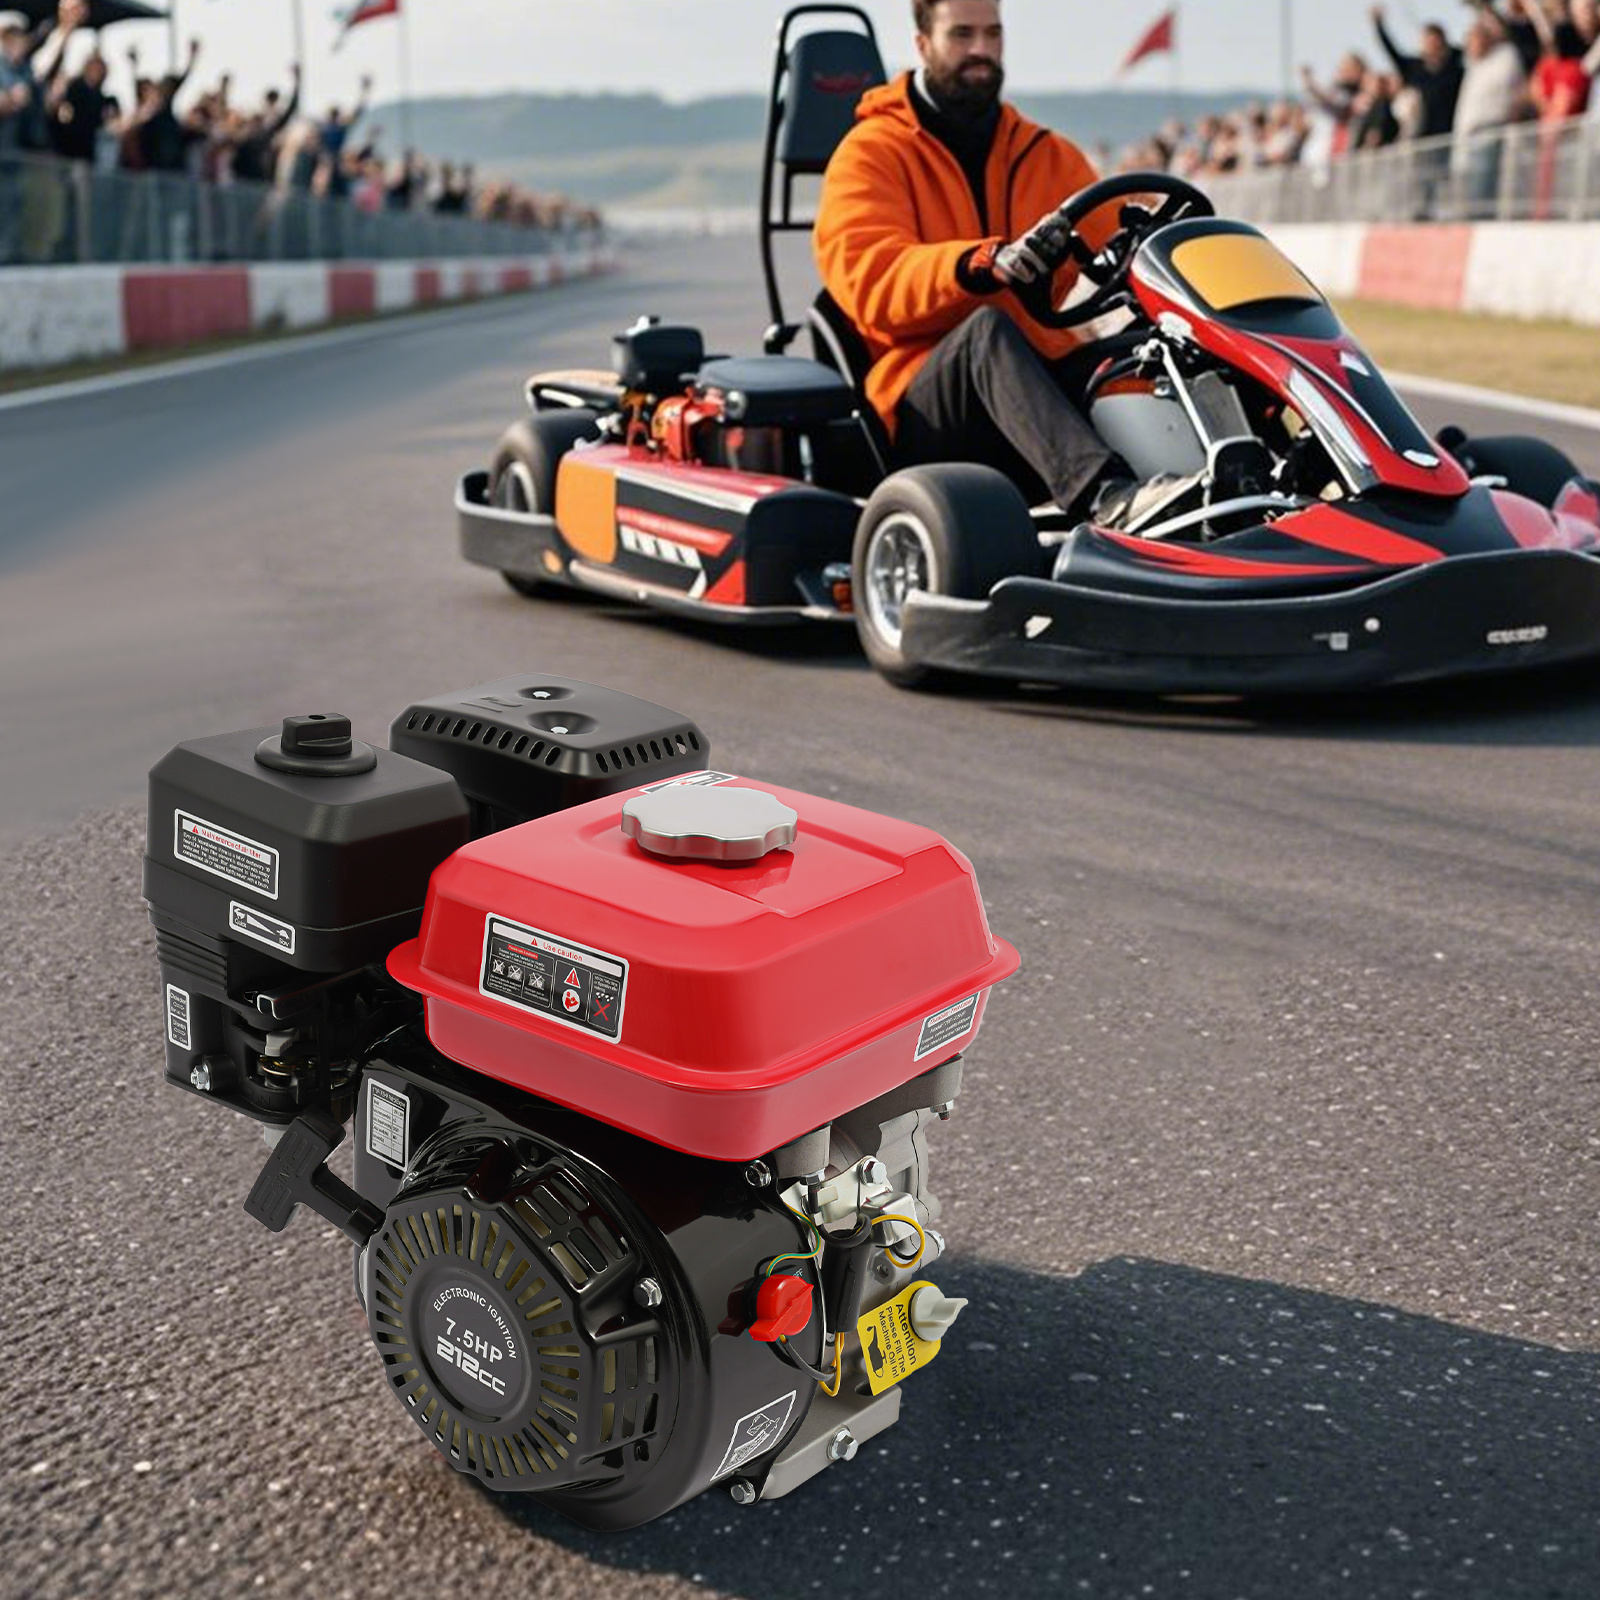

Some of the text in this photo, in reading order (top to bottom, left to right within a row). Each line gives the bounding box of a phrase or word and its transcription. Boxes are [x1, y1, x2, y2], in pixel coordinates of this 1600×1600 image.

[543, 941, 556, 953] Use
[557, 946, 583, 962] caution
[434, 1288, 517, 1359] ELECTRONIC IGNITION
[446, 1317, 503, 1363] 7.5HP
[878, 1310, 892, 1351] Machine
[888, 1351, 896, 1366] Oil
[885, 1306, 906, 1373] Please Fill The
[896, 1304, 917, 1365] Attention
